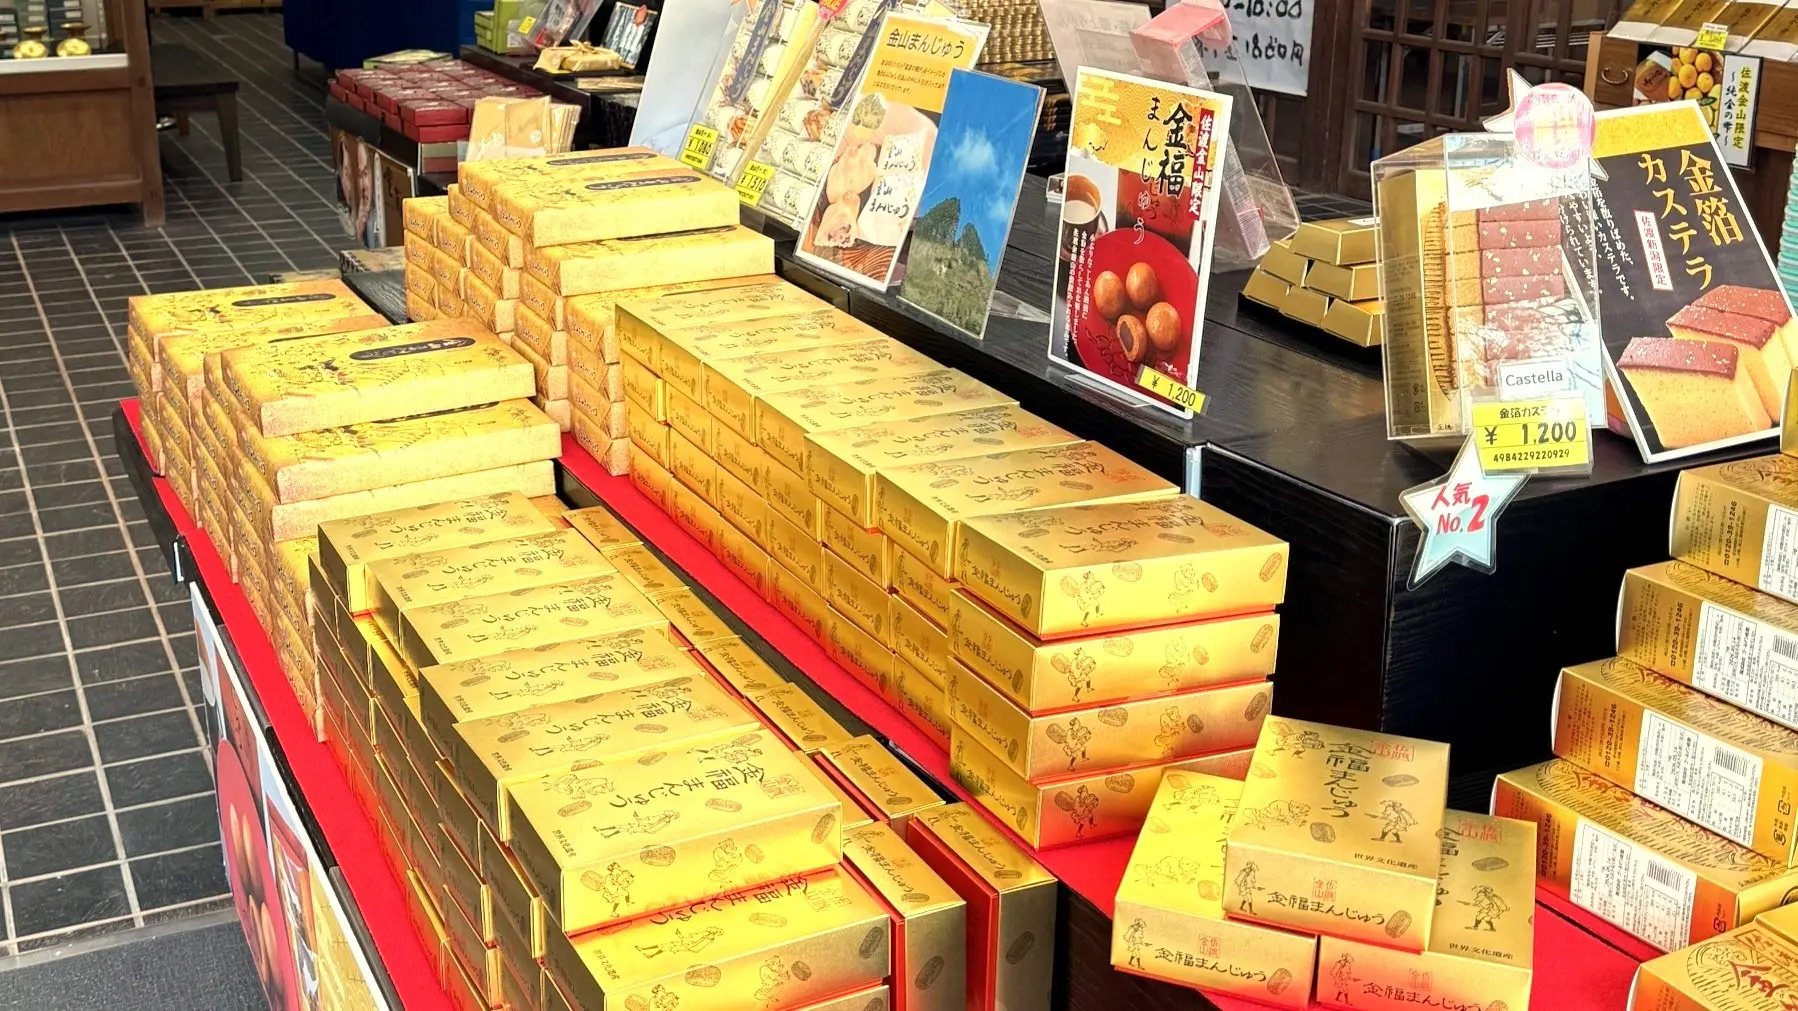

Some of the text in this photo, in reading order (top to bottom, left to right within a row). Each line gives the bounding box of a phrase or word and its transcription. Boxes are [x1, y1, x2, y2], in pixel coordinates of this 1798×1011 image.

[887, 28, 965, 59] 金山まんじゅう
[1733, 66, 1752, 149] 佐渡金山限定
[1133, 96, 1161, 245] まんじゅう
[1158, 102, 1193, 199] 金福
[1188, 114, 1213, 216] 佐渡金山限定
[1679, 149, 1744, 246] 金箔
[1590, 178, 1634, 264] 箔を散りばめた、
[1638, 153, 1713, 291] カステラ
[1641, 215, 1668, 287] 佐渡新潟限定
[838, 382, 957, 405] 金福まんじゅう
[1151, 375, 1196, 407] ¥ 1,200
[1505, 370, 1563, 386] Castella
[892, 420, 1018, 443] 金福まんじゅう
[1500, 406, 1559, 419] 金箔カス
[1484, 421, 1577, 445] ¥ 1,200
[973, 461, 1105, 485] 金福まんじゅう
[1493, 449, 1570, 462] 4984229220929
[1431, 482, 1472, 510] 人気
[1436, 494, 1489, 535] No.2
[390, 508, 508, 534] 金福まんじゅう
[1064, 512, 1205, 536] 金福まんじゅう
[1724, 500, 1737, 560] 0120-39-1246
[442, 547, 565, 574] 金福まんじゅう
[971, 565, 1021, 605] 金福まんじゅう
[483, 594, 612, 624] 金福まんじゅう
[1671, 602, 1684, 659] 0120-39-1246
[505, 649, 643, 681] 金福まんじゅう
[963, 636, 1012, 680] 金福まんじゅう
[546, 698, 693, 734] 金福まんじゅう
[960, 702, 1008, 749] 金福まんじゅう
[1605, 703, 1618, 760] 0120-39-1246
[609, 762, 766, 807] 金福まんじゅう
[850, 753, 898, 798] 金福まんじゅう
[966, 769, 1017, 817] 金福まんじゅう
[1321, 742, 1375, 818] 金福まんじゅう
[950, 815, 1005, 870] 金福まんじゅう
[1354, 852, 1418, 870] 世界文化遺産
[862, 843, 914, 893] 金福まんじゅう
[649, 874, 809, 926] 金福まんじゅう
[1267, 891, 1385, 925] 金福まんじゅう
[1155, 947, 1267, 982] 金福まんじゅう
[1449, 943, 1513, 960] 世界文化遺産
[1363, 982, 1482, 1011] 金福まんじゅう
